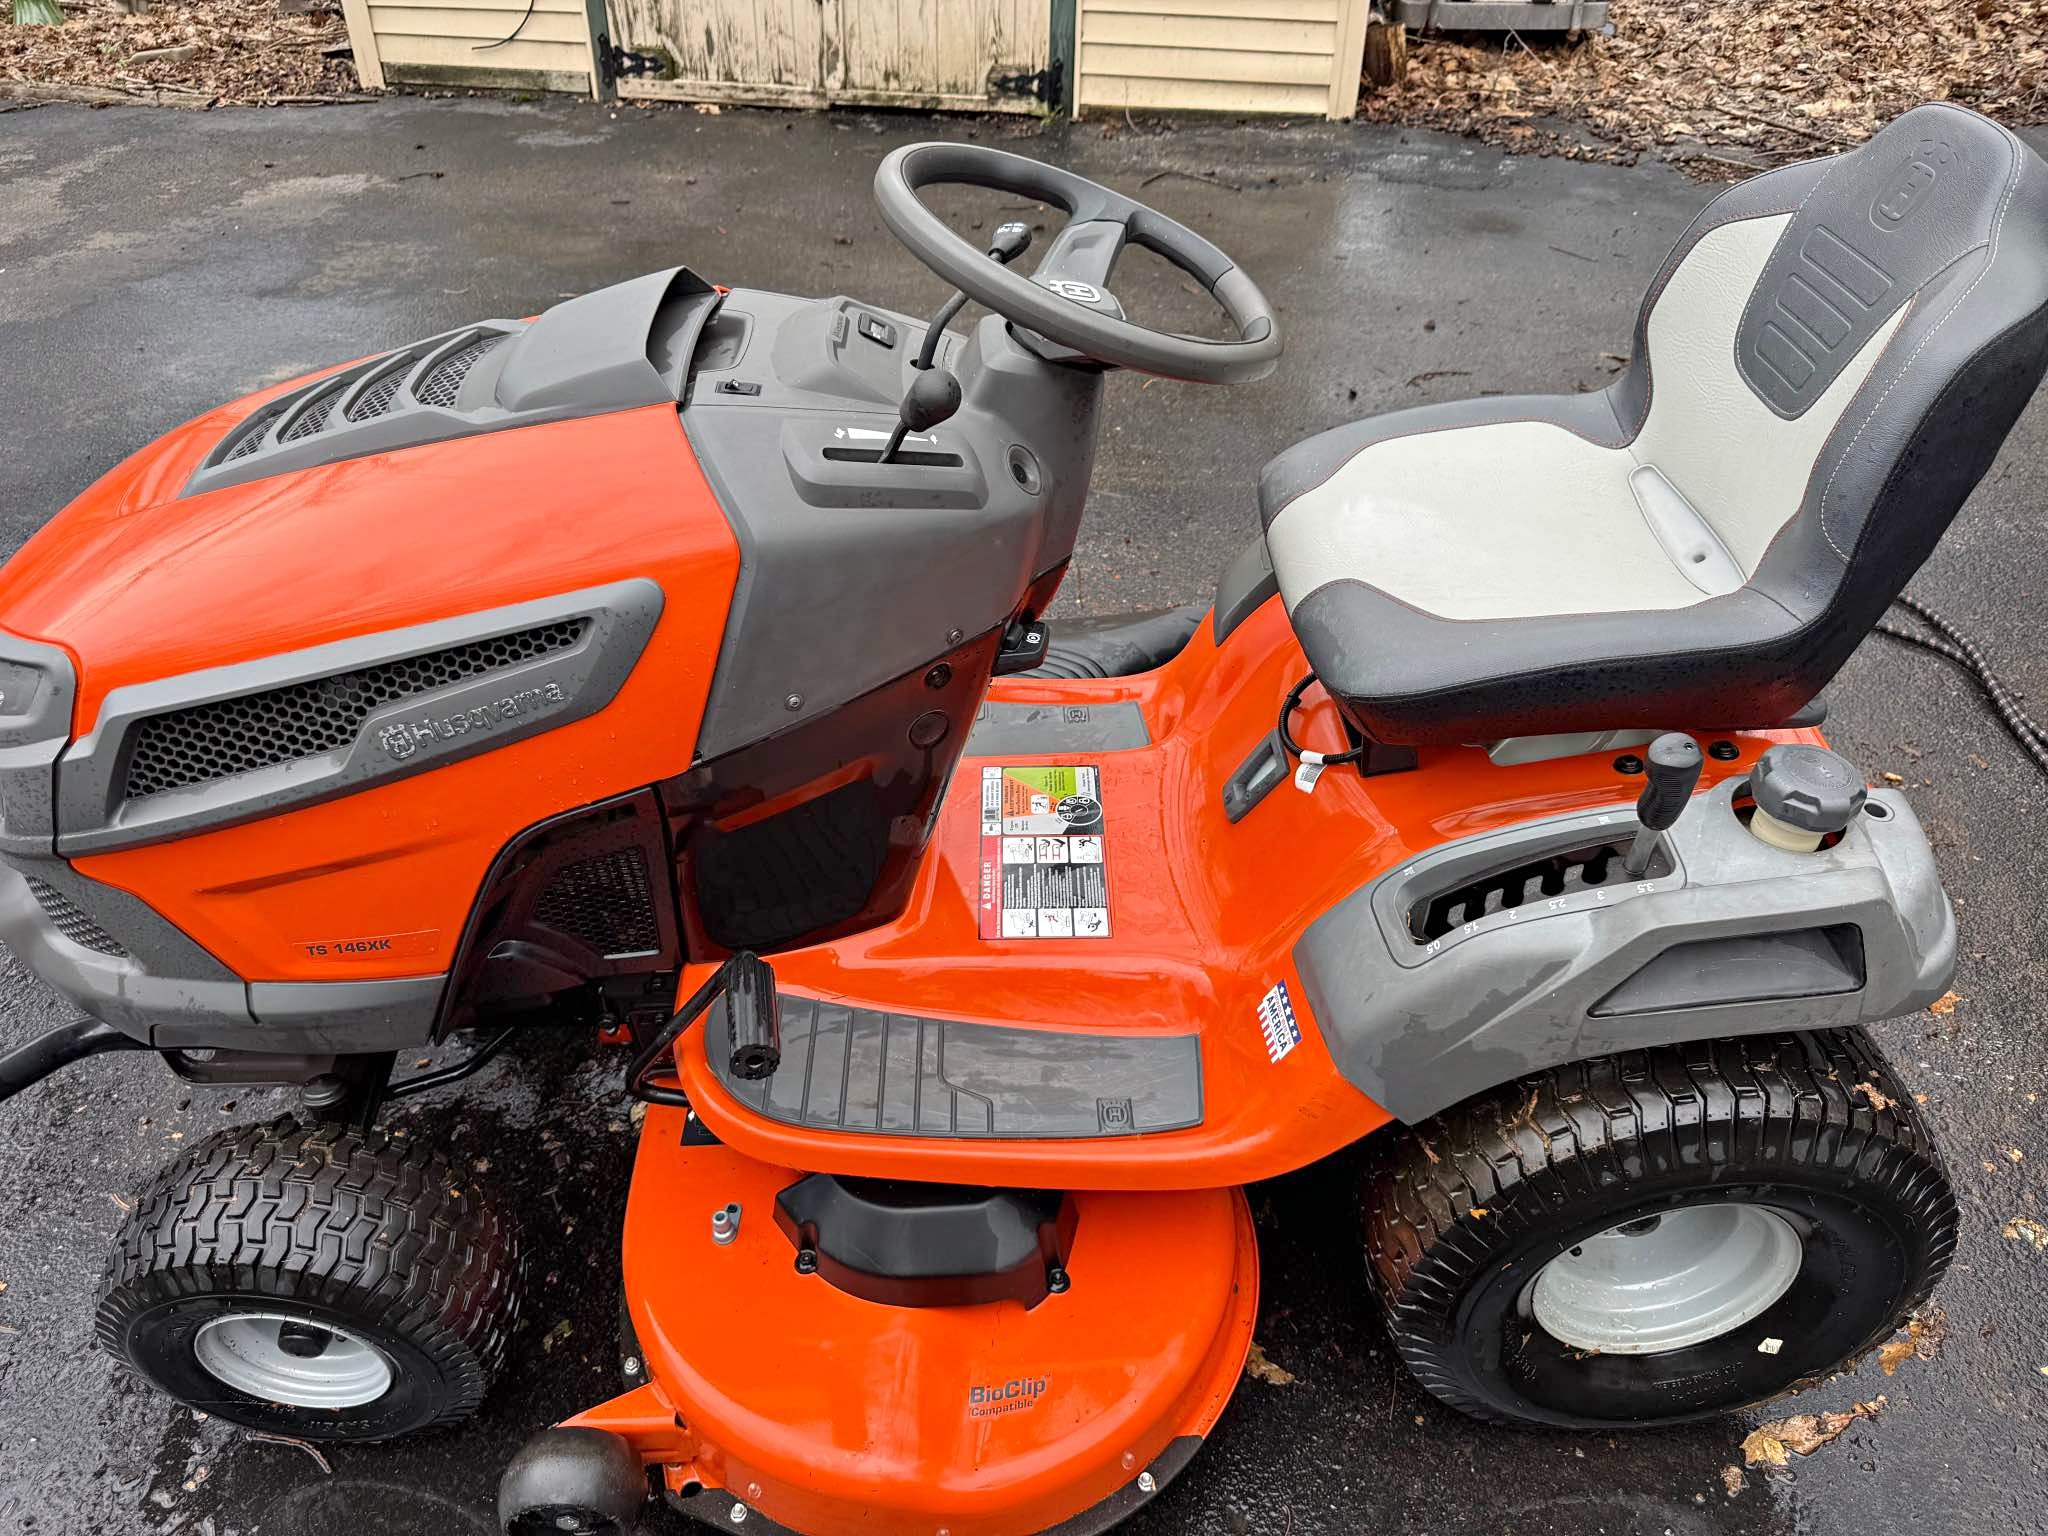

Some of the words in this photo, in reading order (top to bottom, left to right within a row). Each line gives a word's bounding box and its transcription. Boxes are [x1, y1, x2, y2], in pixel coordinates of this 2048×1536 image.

[411, 680, 564, 748] Husqvarna
[984, 861, 992, 899] DANGER
[1637, 882, 1655, 894] 3.5
[1596, 890, 1606, 900] 3
[1548, 898, 1567, 910] 2.5
[1509, 910, 1517, 920] 2
[1463, 921, 1479, 934] 1.5
[306, 945, 328, 956] TS
[333, 939, 392, 954] 146XK
[1426, 940, 1441, 955] 0.5
[1266, 995, 1288, 1053] AMERICA
[970, 1376, 1047, 1404] BioClip
[971, 1399, 1033, 1417] Compatible
